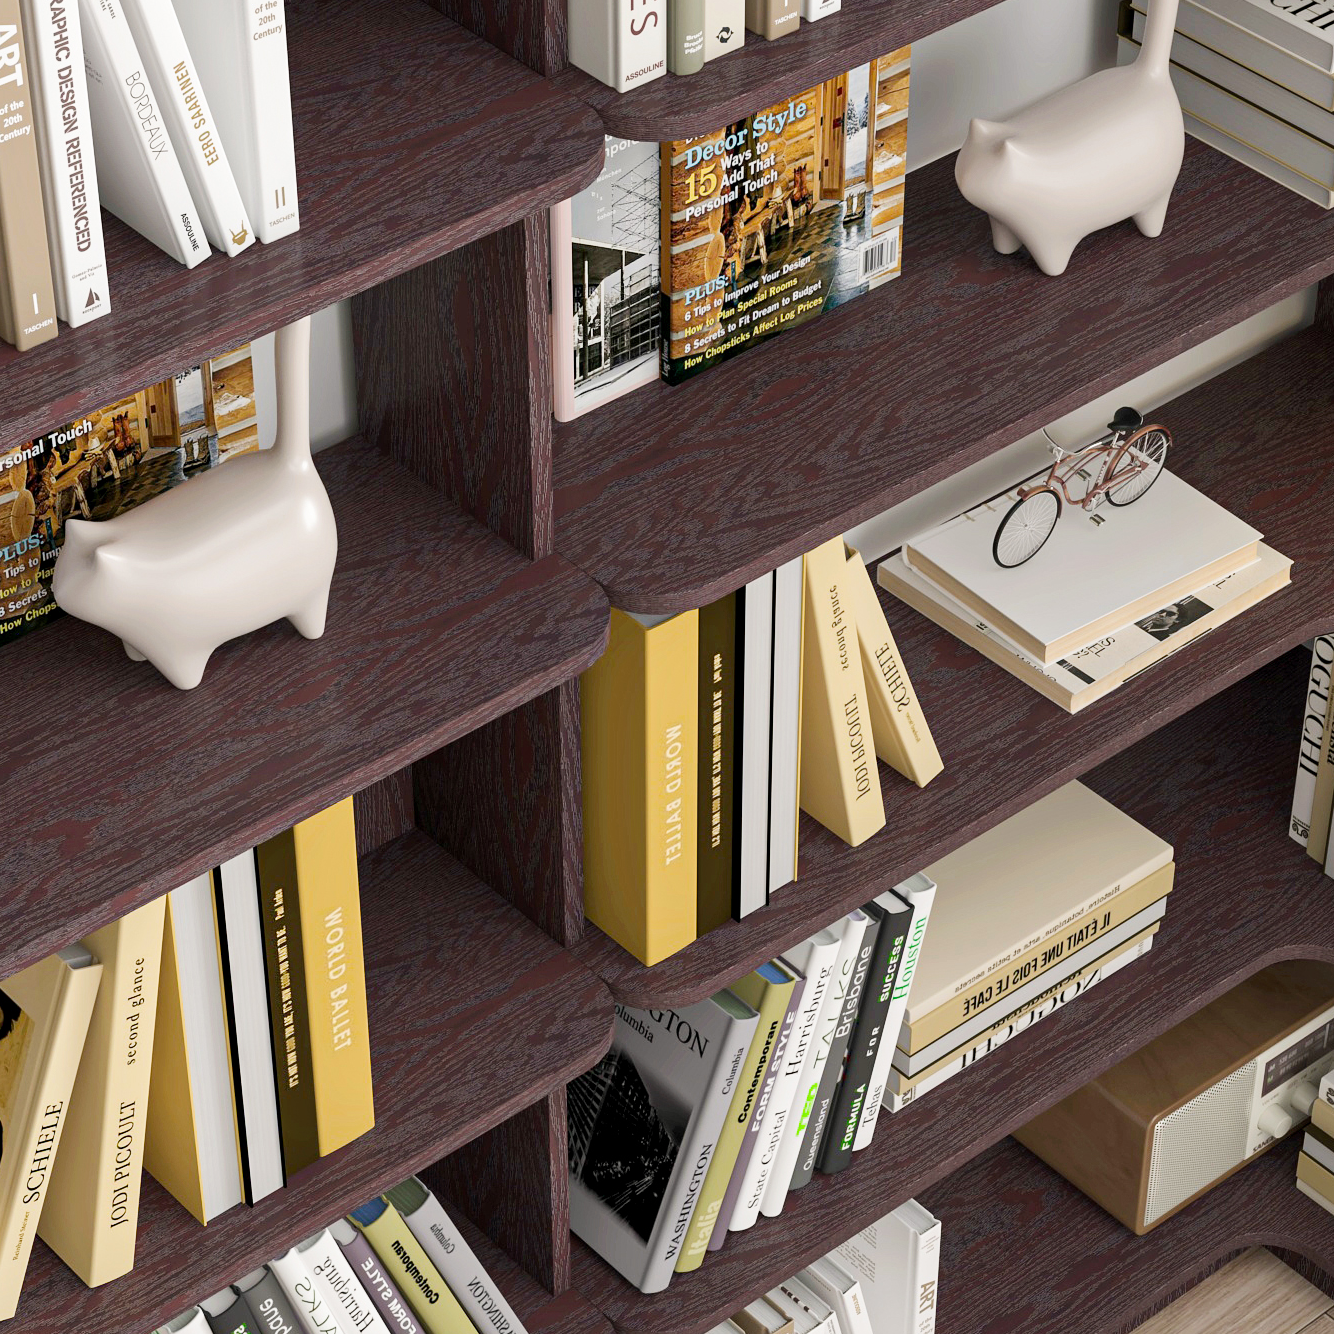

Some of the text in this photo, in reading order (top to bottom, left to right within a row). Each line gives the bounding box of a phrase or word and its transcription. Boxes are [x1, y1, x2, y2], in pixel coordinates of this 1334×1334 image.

[3, 113, 22, 128] 20th
[57, 65, 79, 134] DESIGN
[125, 71, 168, 161] BORDEAUX
[173, 60, 219, 167] EERO SAARINEN
[684, 100, 808, 170] Decor Style
[65, 137, 91, 253] REFERENCED
[684, 164, 718, 205] 15
[720, 149, 752, 172] Ways
[684, 170, 778, 222] Personal Touch
[720, 156, 776, 189] Add That
[180, 213, 200, 252] ASSOULINE
[269, 212, 296, 228] TASCHEN
[684, 274, 729, 306] PLUS:
[684, 324, 704, 338] How
[717, 307, 735, 324] Plan
[737, 291, 767, 316] Special
[769, 277, 798, 296] Rooms
[693, 299, 712, 317] Tips
[724, 278, 759, 303] Improve
[761, 267, 780, 285] Your
[782, 255, 811, 278] Design
[693, 327, 726, 350] Secrets
[752, 299, 780, 320] Dream
[792, 279, 822, 302] Budget
[24, 318, 53, 335] TASCHEN
[705, 331, 751, 361] Chopsticks
[753, 318, 778, 337] Affect
[780, 310, 796, 326] Log
[797, 297, 823, 316] Prices
[48, 419, 93, 450] Touch
[324, 907, 352, 1052] WORLD BALLET
[836, 946, 870, 1038] Brisbane
[892, 916, 927, 1001] Houston
[126, 1012, 141, 1066] second
[785, 965, 834, 1077] Harrisburg
[842, 1084, 867, 1151] FORMULA
[878, 936, 904, 1002] SUCCESS
[738, 1021, 779, 1124] Contemporan
[751, 1011, 797, 1132] FORM STYLE
[22, 1101, 64, 1205] SCHIELE
[110, 1101, 136, 1229] JODI PICOULT
[803, 1098, 829, 1171] Queensland
[665, 1143, 713, 1262] WASHINGTON
